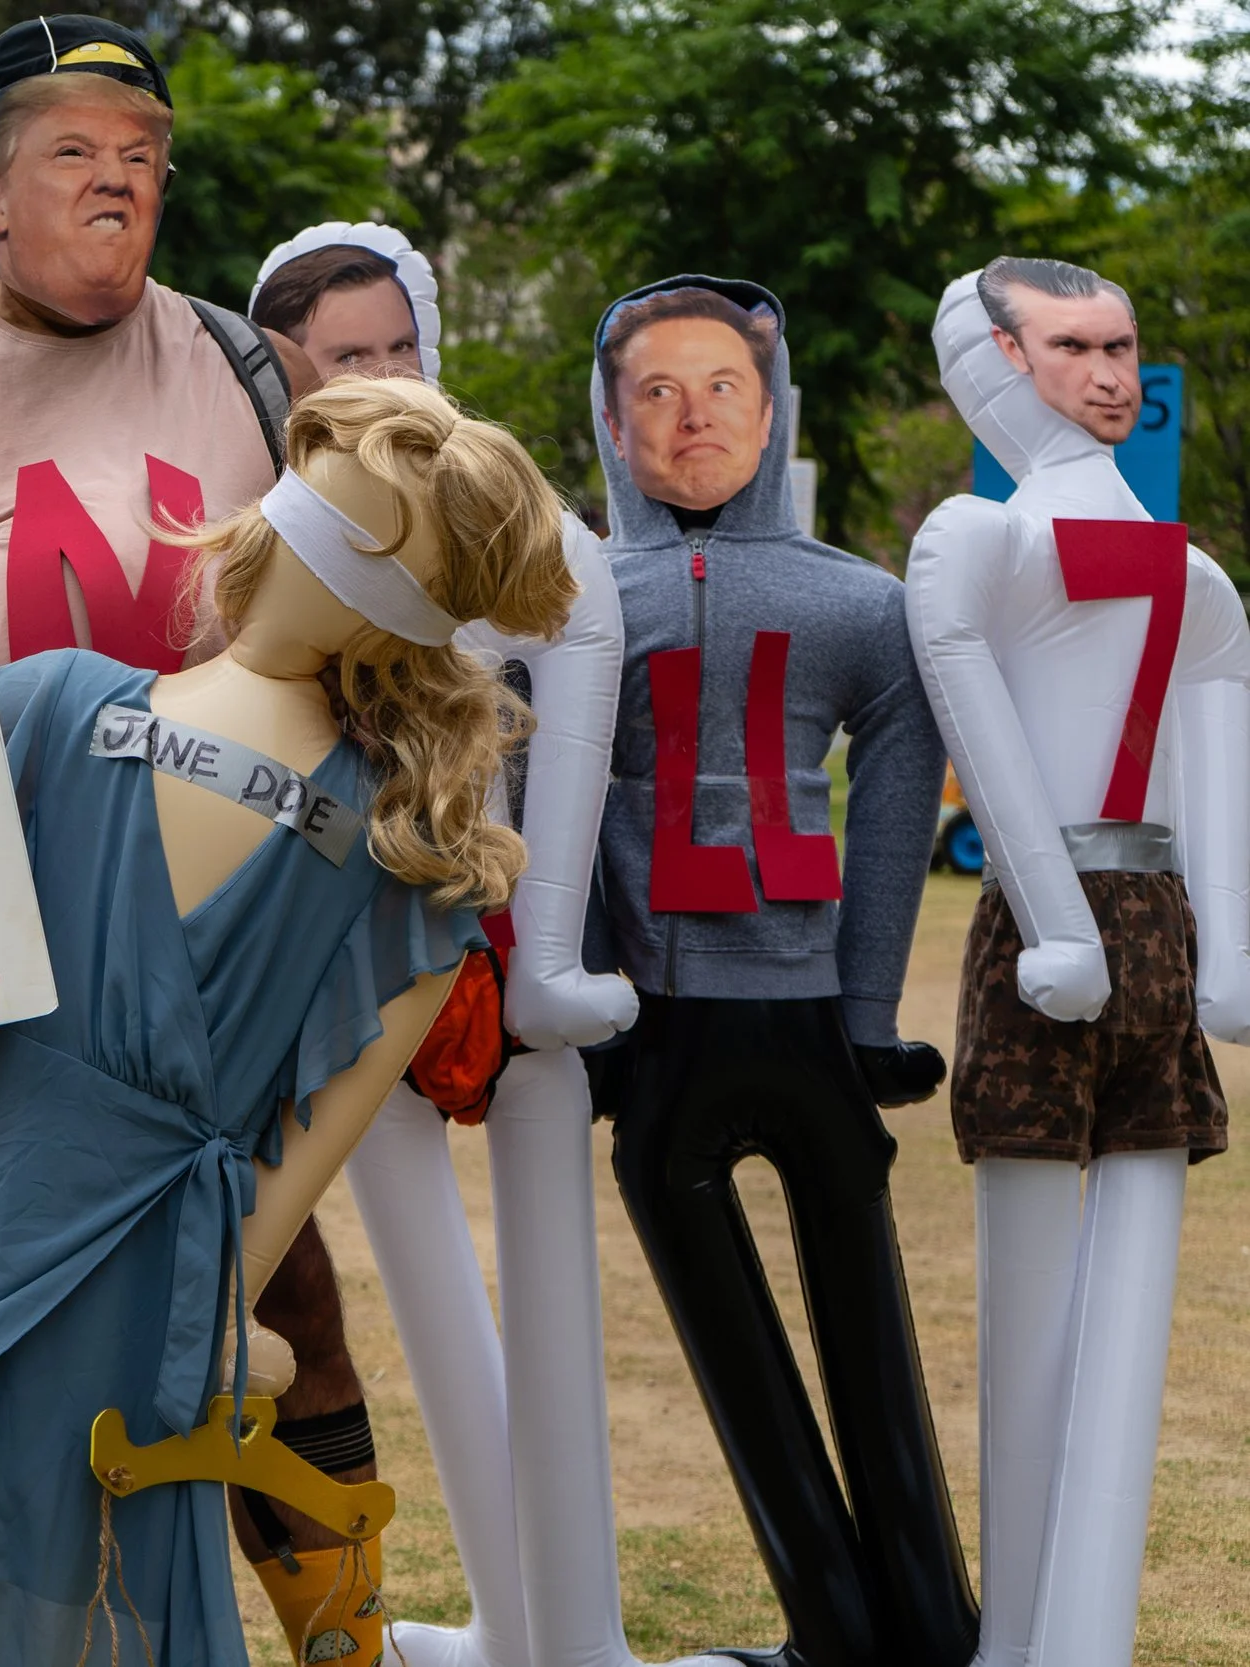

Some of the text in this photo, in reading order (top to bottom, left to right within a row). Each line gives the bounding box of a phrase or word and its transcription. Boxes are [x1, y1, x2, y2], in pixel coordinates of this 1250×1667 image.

[6, 453, 205, 674] N
[102, 715, 338, 835] JANE DOE
